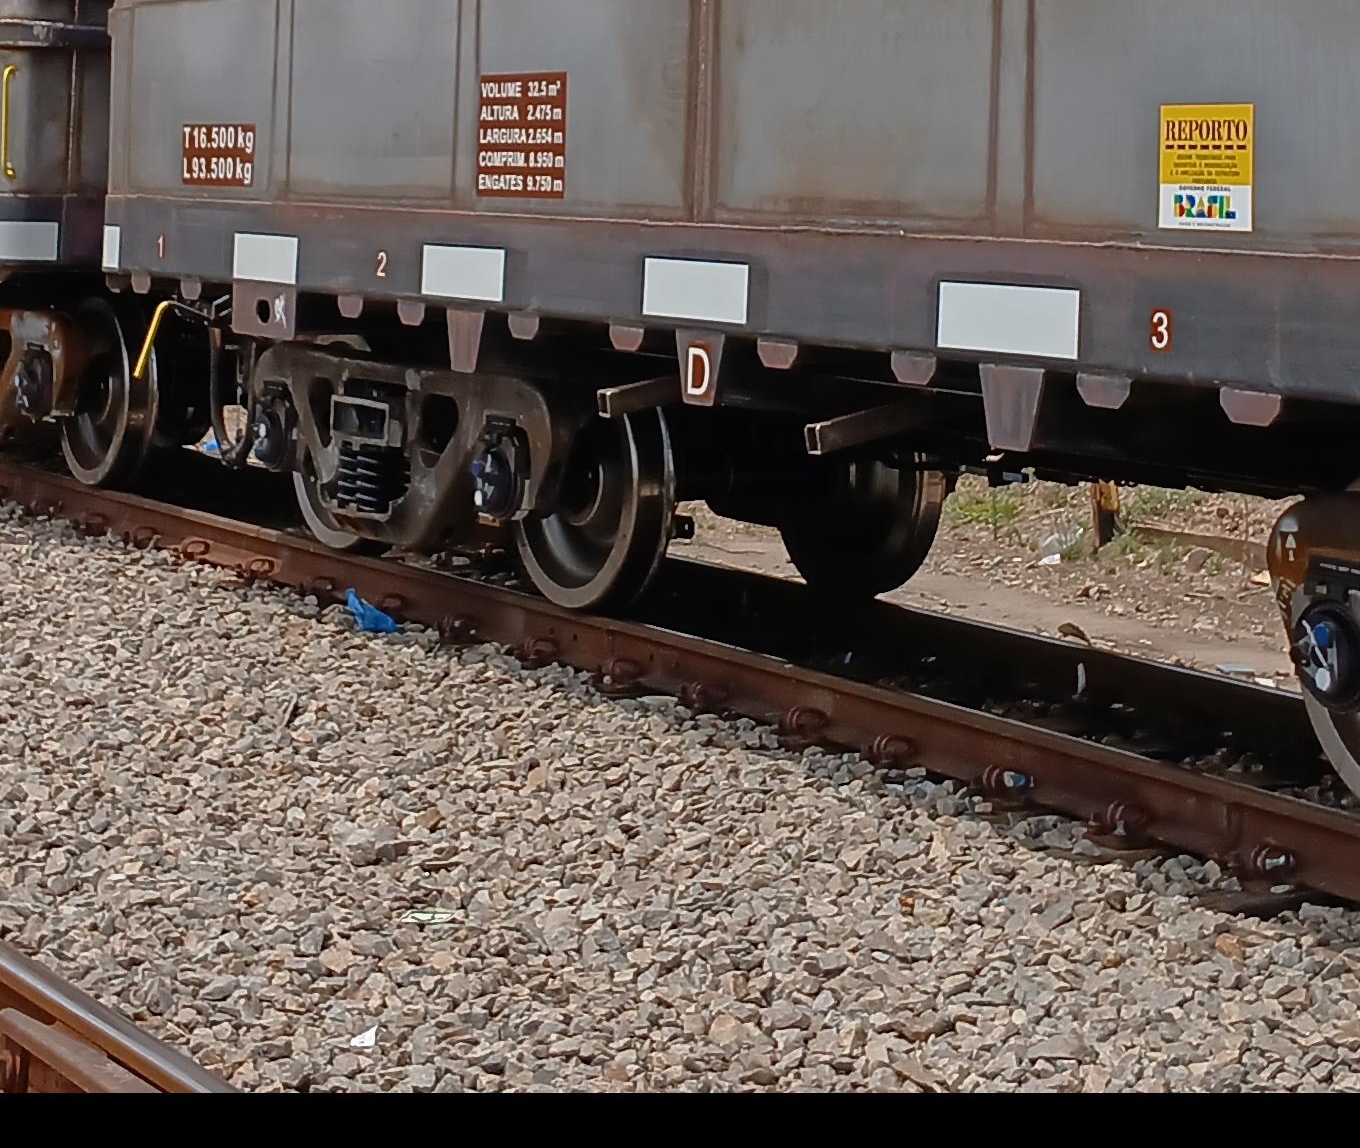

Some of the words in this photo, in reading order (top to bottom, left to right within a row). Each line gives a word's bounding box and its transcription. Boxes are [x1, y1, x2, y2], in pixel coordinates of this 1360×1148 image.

[481, 82, 522, 98] VOLUME
[480, 105, 520, 121] ALTURA
[527, 104, 552, 121] 2.475
[183, 127, 191, 149] T
[193, 126, 235, 149] 16.500
[237, 126, 254, 154] kg
[479, 128, 527, 144] LARGURA
[1165, 119, 1248, 142] REPORTO
[183, 157, 191, 178] L
[192, 157, 234, 179] 93.500
[235, 157, 252, 185] kg
[478, 174, 524, 191] ENGATES
[1174, 194, 1237, 220] BRASIL
[157, 235, 165, 258] 1
[376, 251, 388, 277] 2
[1152, 312, 1168, 348] 3
[687, 346, 710, 396] D
